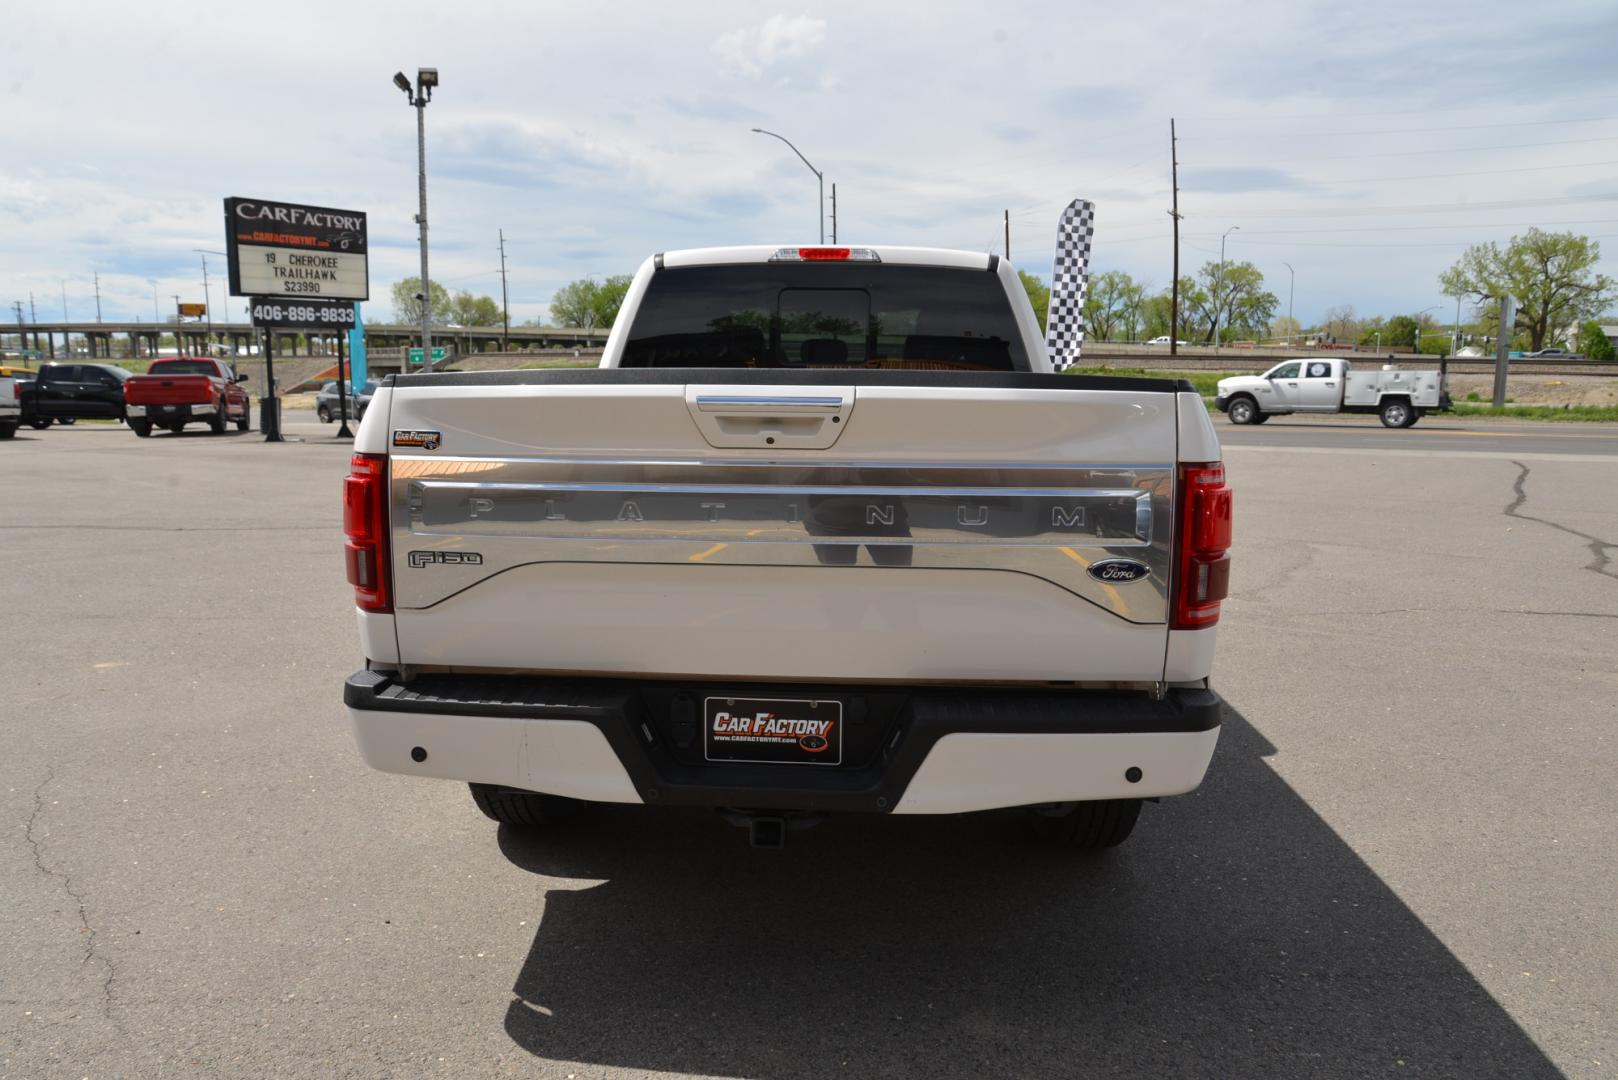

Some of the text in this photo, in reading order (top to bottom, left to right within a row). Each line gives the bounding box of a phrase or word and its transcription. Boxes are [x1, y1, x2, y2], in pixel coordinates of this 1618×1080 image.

[265, 253, 338, 268] 19 CHEROKEE
[273, 267, 337, 281] TRAILHAWK
[253, 305, 355, 322] 406-896-9833
[468, 497, 1085, 527] PLATINUM
[1102, 563, 1136, 579] Ford
